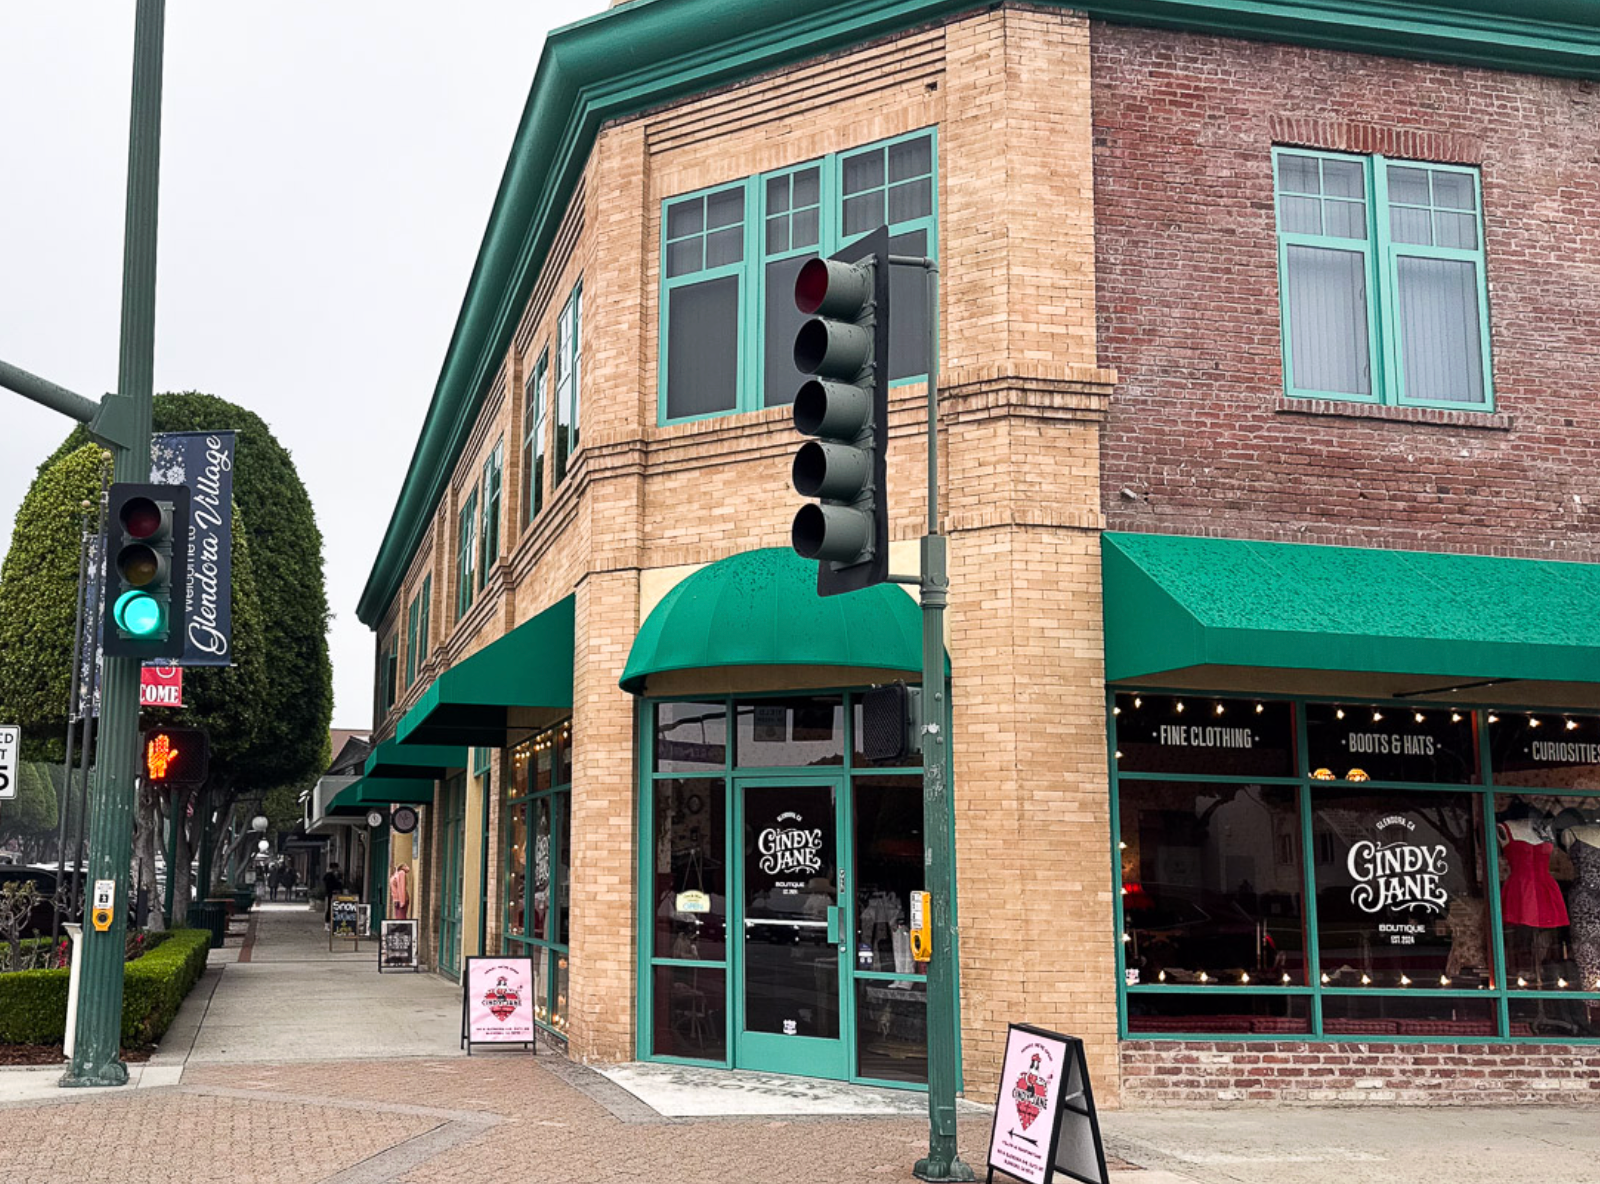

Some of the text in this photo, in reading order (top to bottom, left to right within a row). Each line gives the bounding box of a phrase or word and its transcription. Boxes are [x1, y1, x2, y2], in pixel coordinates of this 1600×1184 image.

[189, 434, 231, 655] Glendora Village
[1160, 725, 1253, 748] FINE CLOTHING
[1349, 732, 1434, 756] BOOTS & HATS
[758, 828, 822, 855] CINDY
[759, 848, 822, 875] JANE
[1347, 840, 1449, 882] CINDY
[1350, 873, 1448, 913] JANE
[1378, 923, 1426, 934] BOUTIQUE
